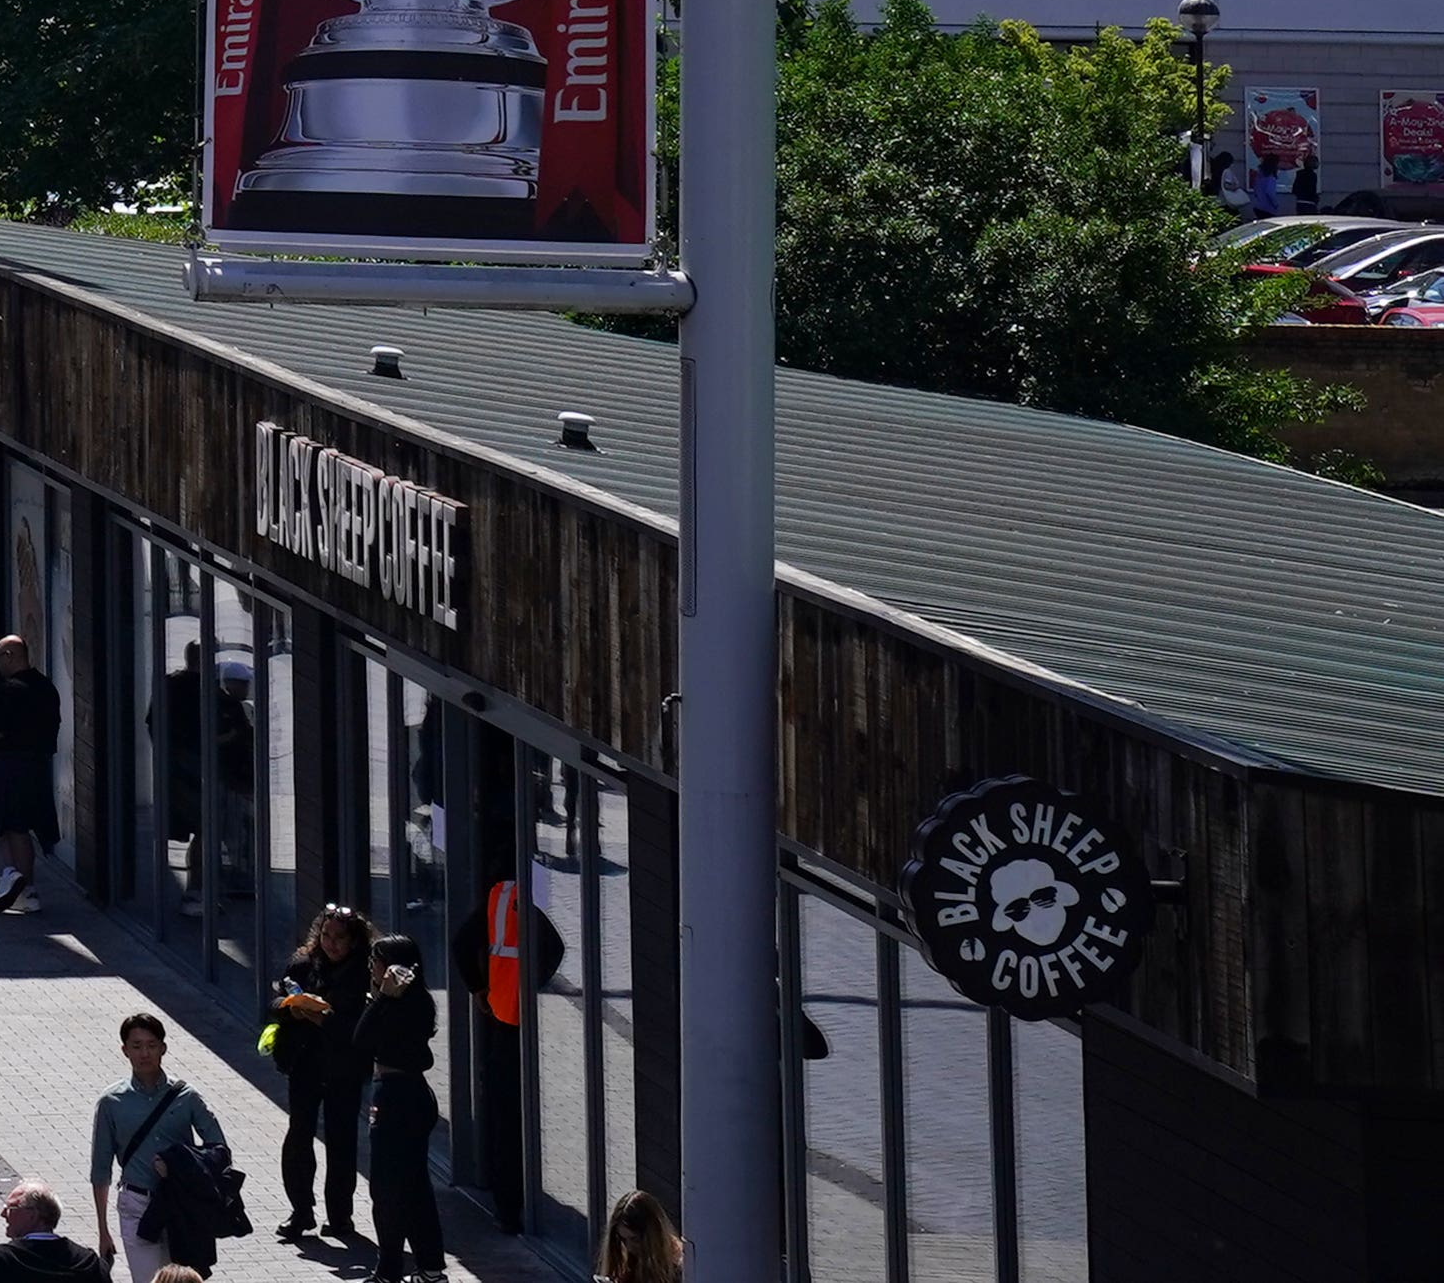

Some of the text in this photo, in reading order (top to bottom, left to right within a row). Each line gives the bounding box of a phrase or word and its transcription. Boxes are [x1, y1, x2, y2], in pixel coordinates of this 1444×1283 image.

[256, 422, 459, 631] BLACK SHEEP COFFEE
[934, 802, 1121, 927] BLACK SHEEP
[991, 915, 1128, 999] COFFEE
